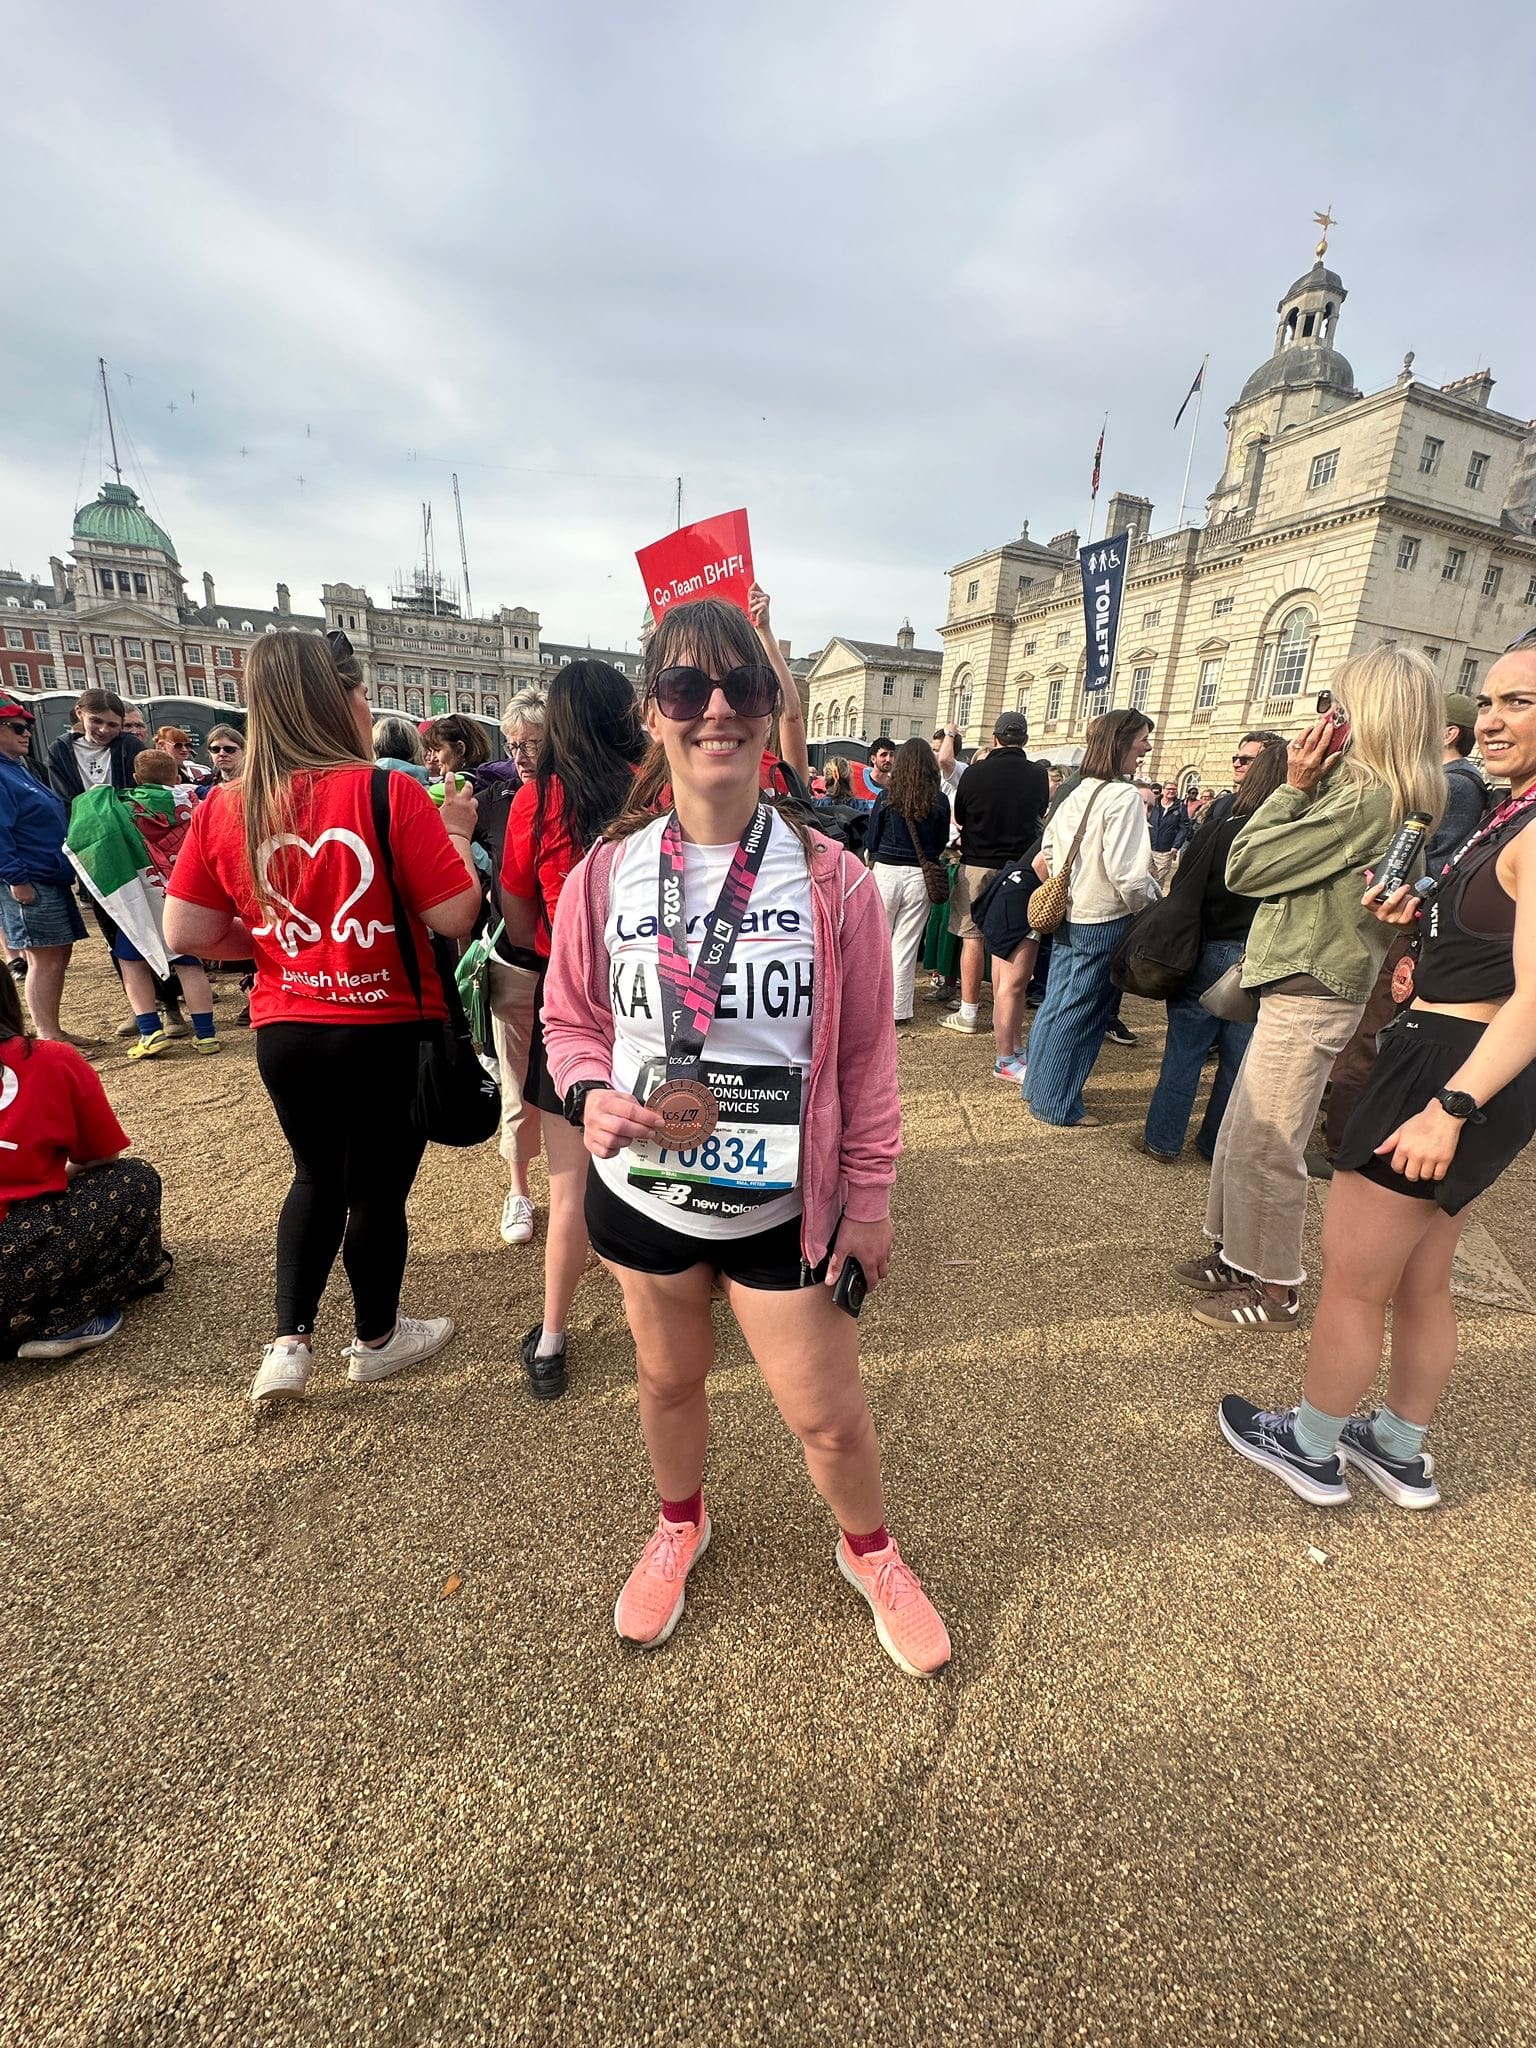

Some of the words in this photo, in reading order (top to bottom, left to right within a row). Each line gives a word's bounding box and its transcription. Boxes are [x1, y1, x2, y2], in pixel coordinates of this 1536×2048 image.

[653, 588, 671, 607] Go
[669, 575, 704, 599] Team
[703, 554, 745, 585] BHF!
[1095, 579, 1111, 668] TOILETS
[664, 876, 681, 928] 2026
[616, 908, 801, 941] Laare
[704, 943, 725, 965] tcs
[335, 969, 391, 988] Heart
[613, 959, 814, 1020] KAEIGH
[707, 1072, 744, 1086] TATA
[715, 1101, 760, 1114] RVICES
[692, 1198, 720, 1211] new
